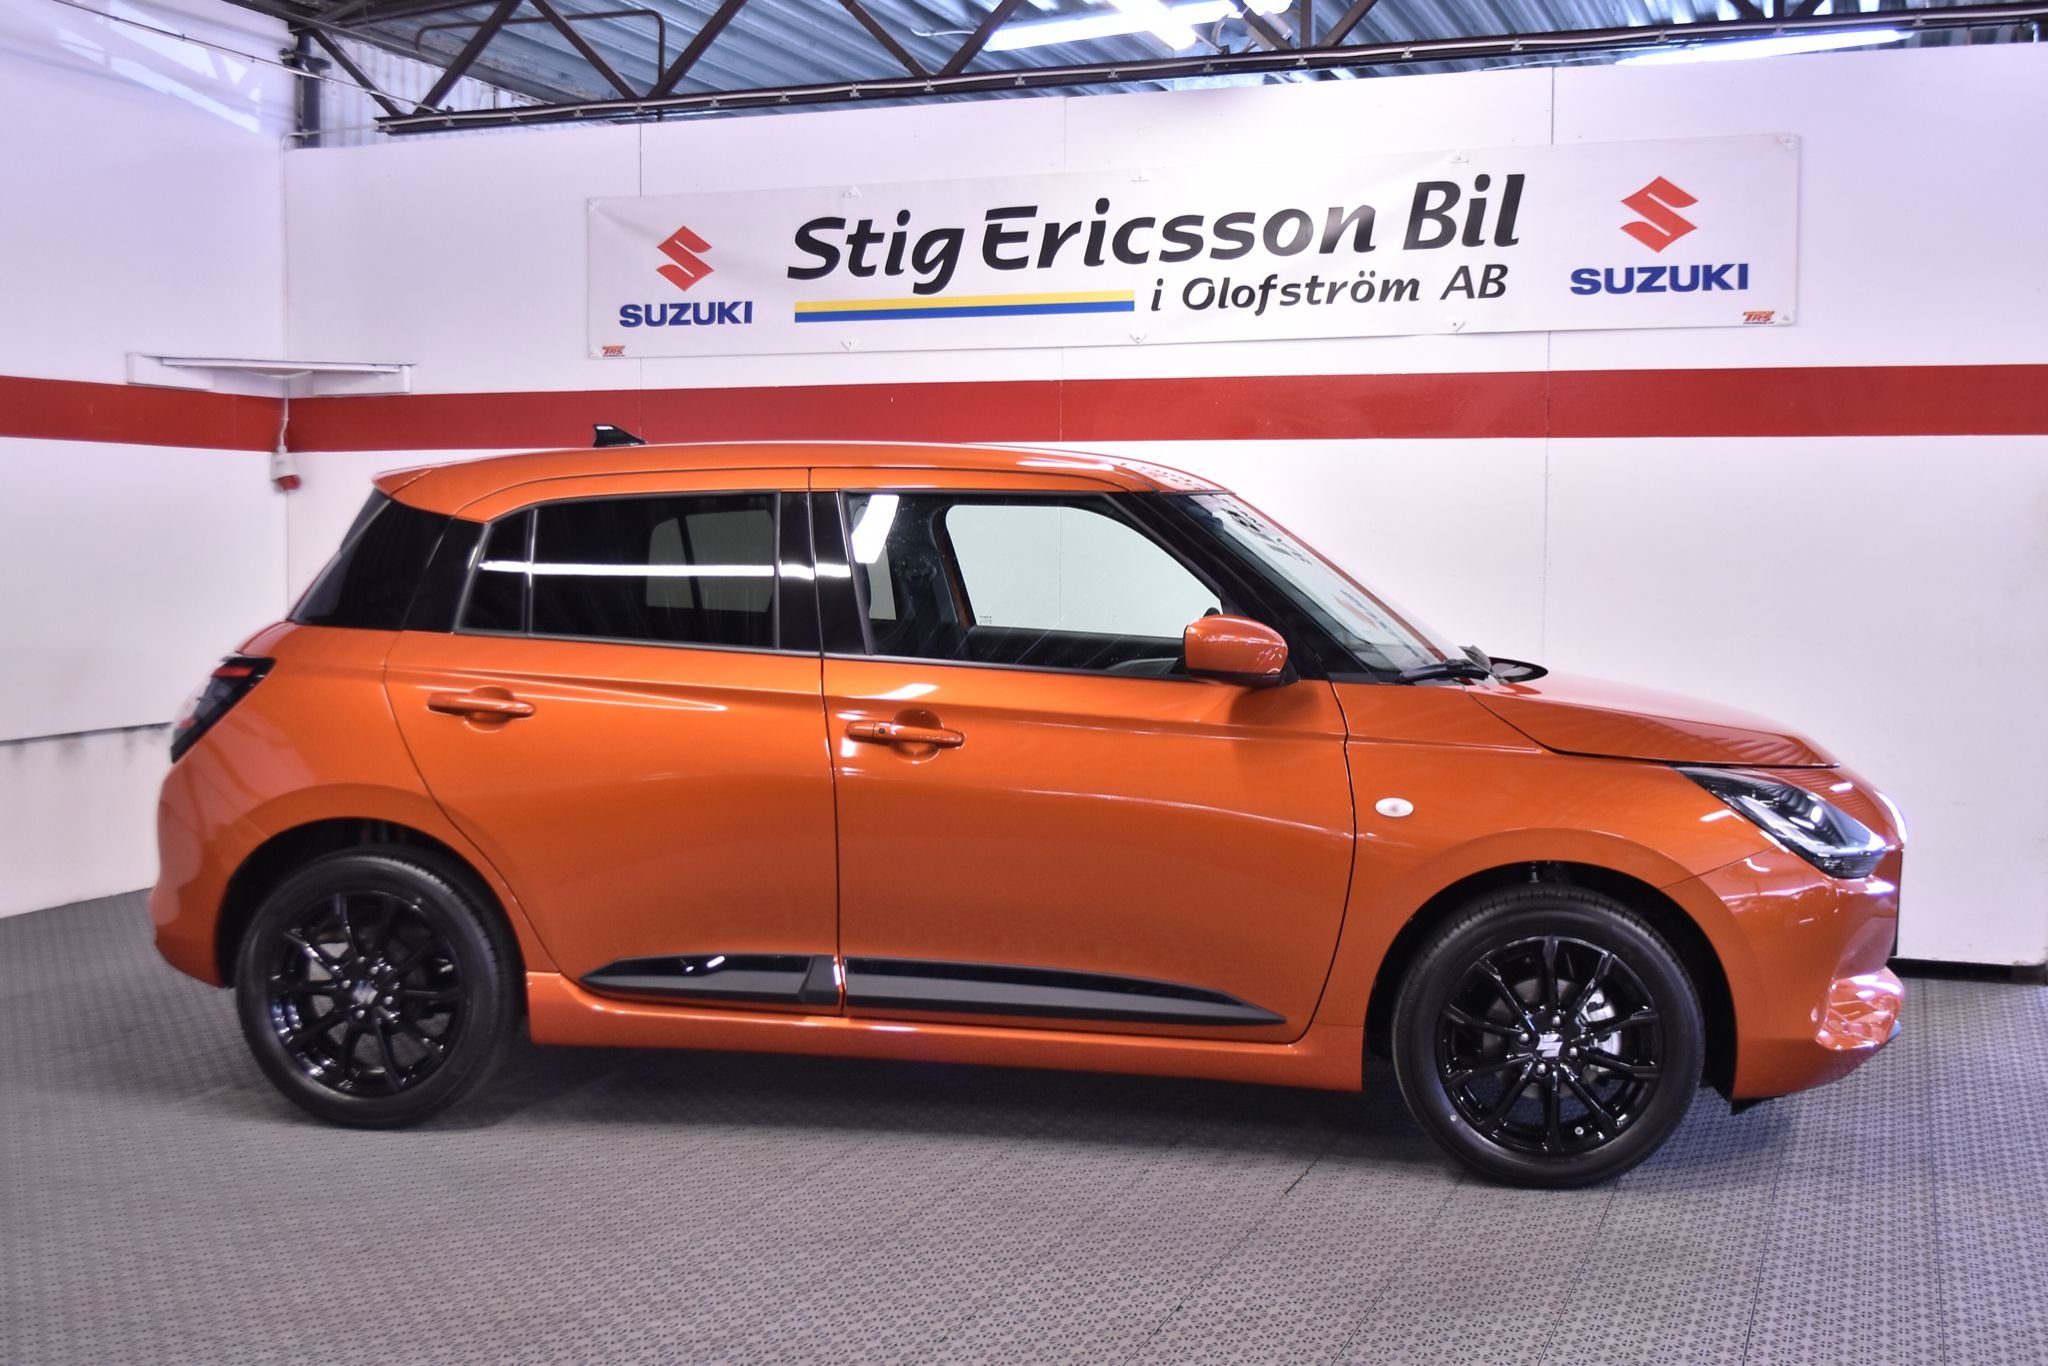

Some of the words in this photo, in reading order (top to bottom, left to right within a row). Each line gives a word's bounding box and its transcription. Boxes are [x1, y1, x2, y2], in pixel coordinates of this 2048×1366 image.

[787, 209, 965, 296] Stig
[981, 197, 1377, 271] Ericsson
[1403, 173, 1526, 250] Bil
[1150, 278, 1164, 312] i
[1182, 271, 1420, 316] Olofström
[1440, 263, 1509, 300] AB
[1570, 263, 1749, 296] SUZUKI
[618, 301, 753, 328] SUZUKI
